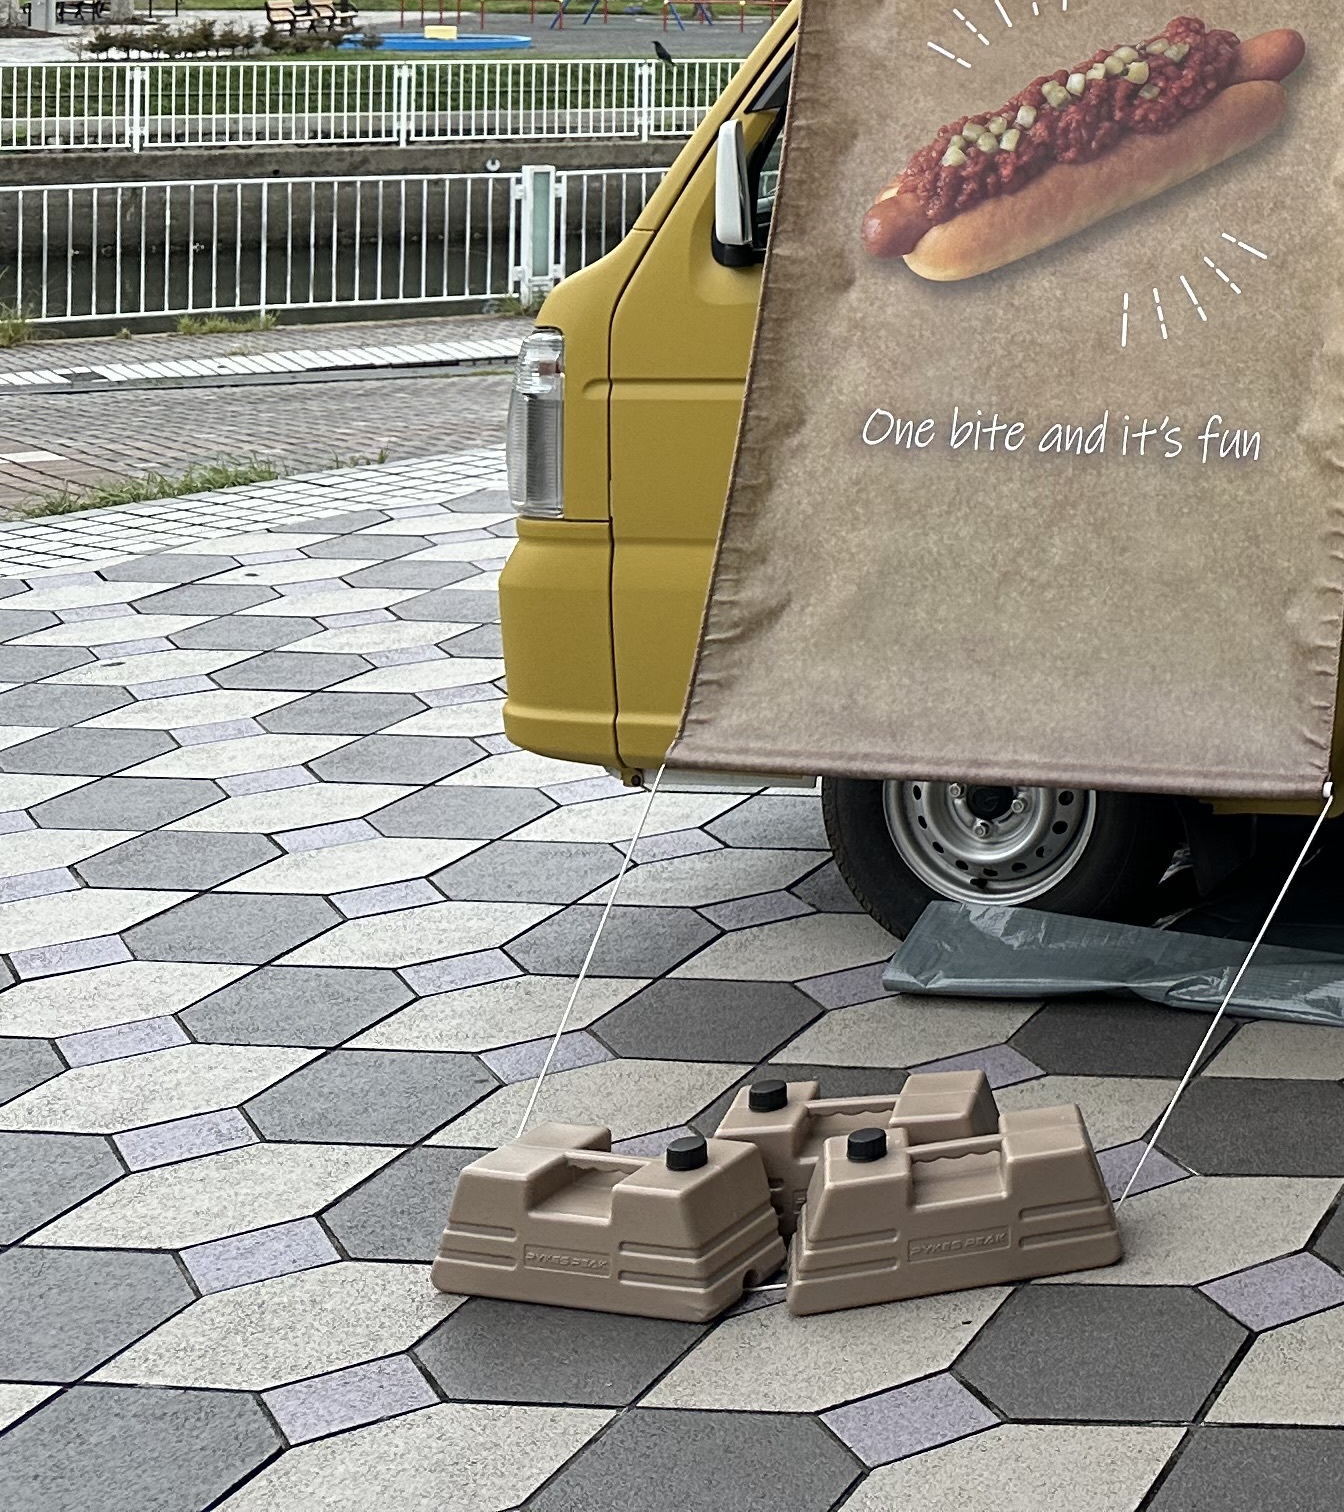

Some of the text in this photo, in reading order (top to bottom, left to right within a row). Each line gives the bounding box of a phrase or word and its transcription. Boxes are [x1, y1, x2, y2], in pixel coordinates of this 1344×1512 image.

[862, 406, 1261, 463] One bite and it's fun
